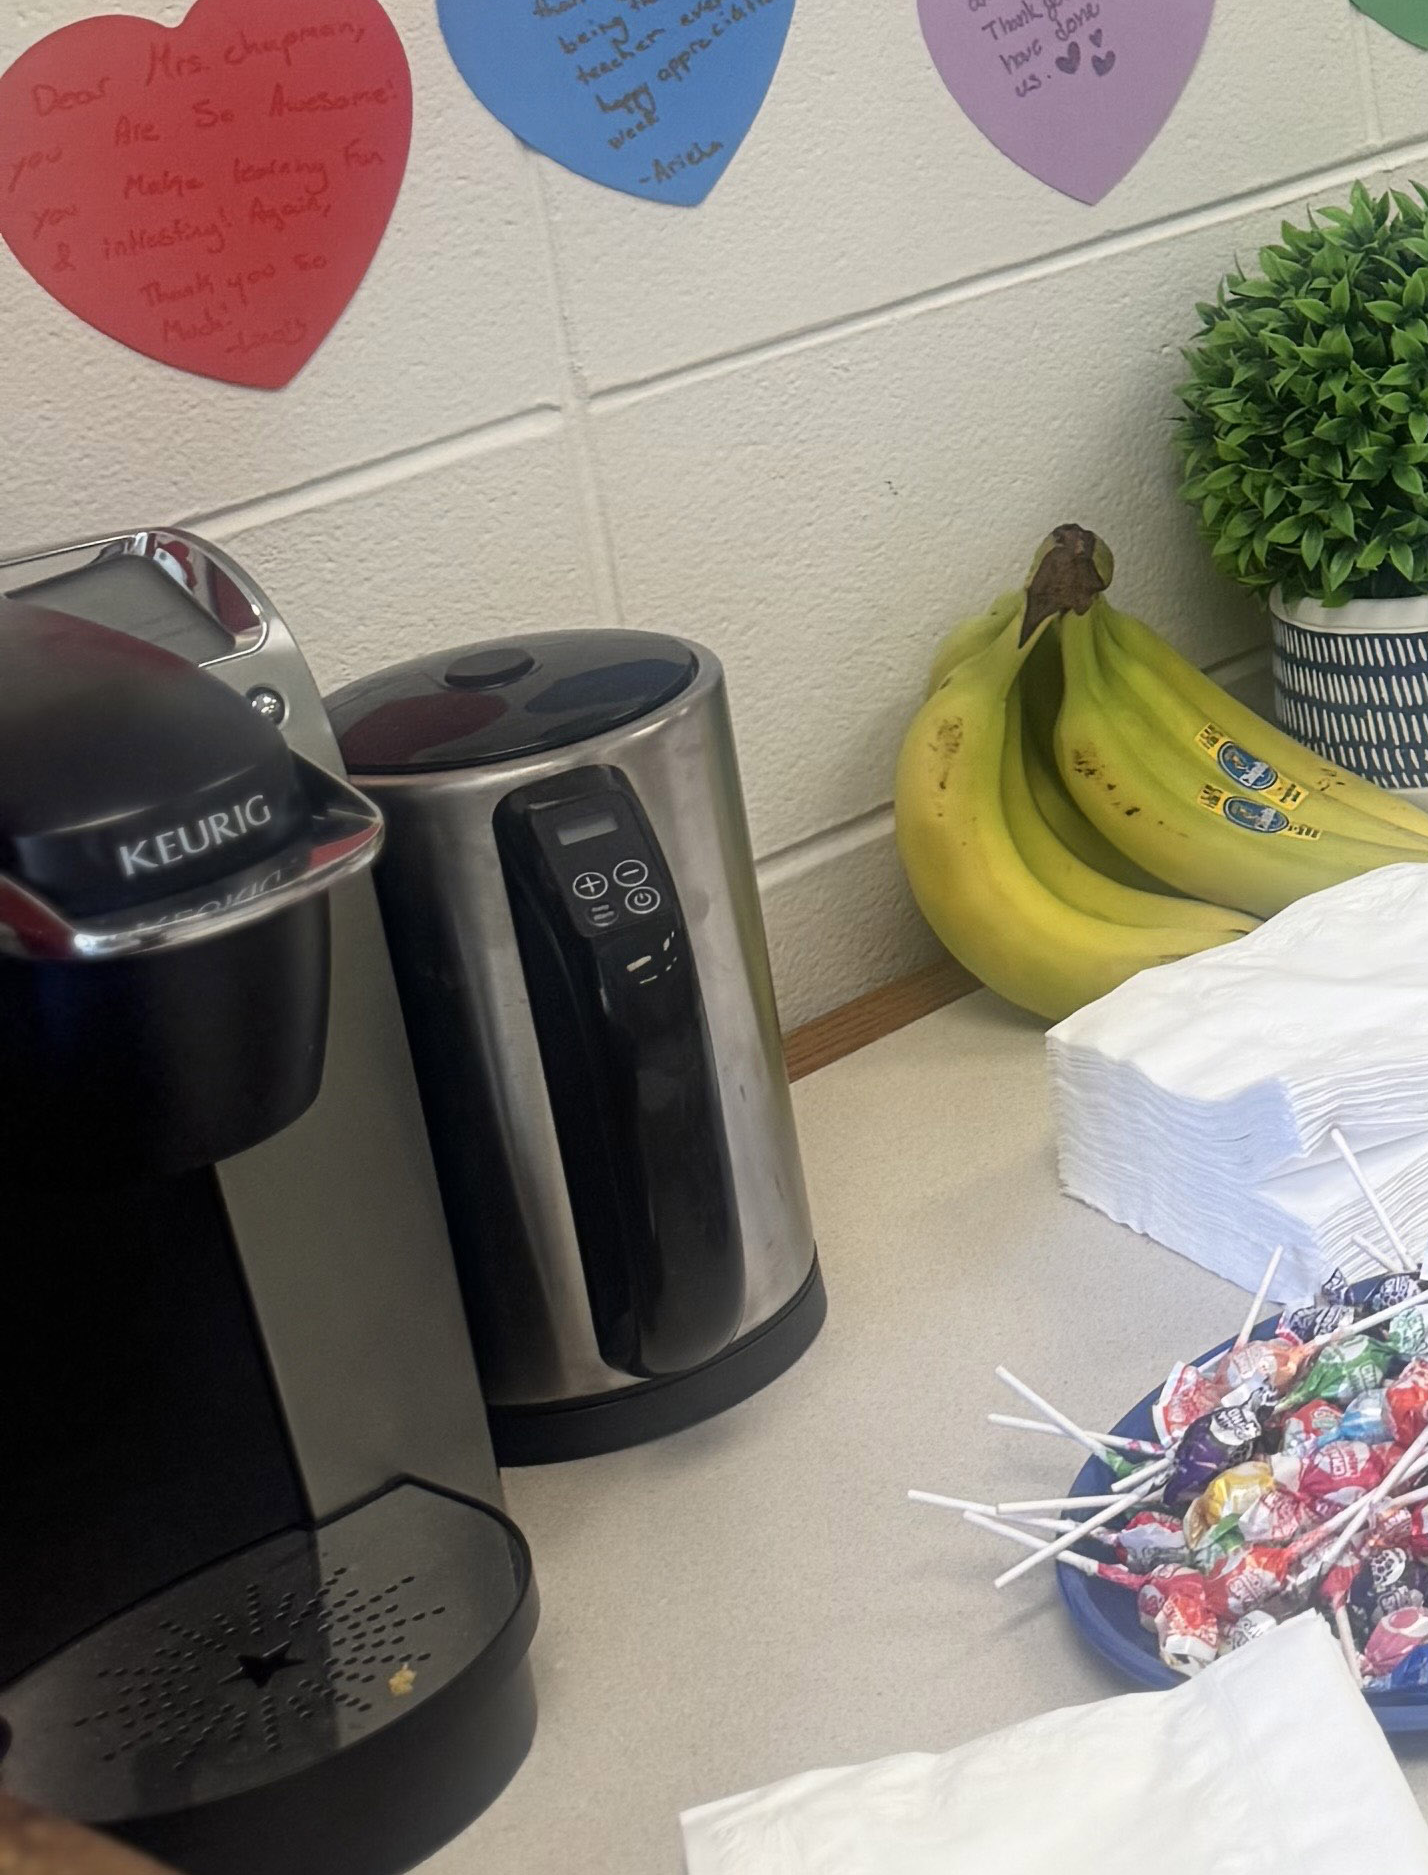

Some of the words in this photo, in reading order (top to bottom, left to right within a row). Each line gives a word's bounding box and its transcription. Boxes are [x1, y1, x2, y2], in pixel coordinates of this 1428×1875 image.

[981, 0, 1044, 41] Thank
[999, 38, 1043, 75] have
[1055, 1, 1100, 42] done
[120, 795, 271, 876] KEURIG
